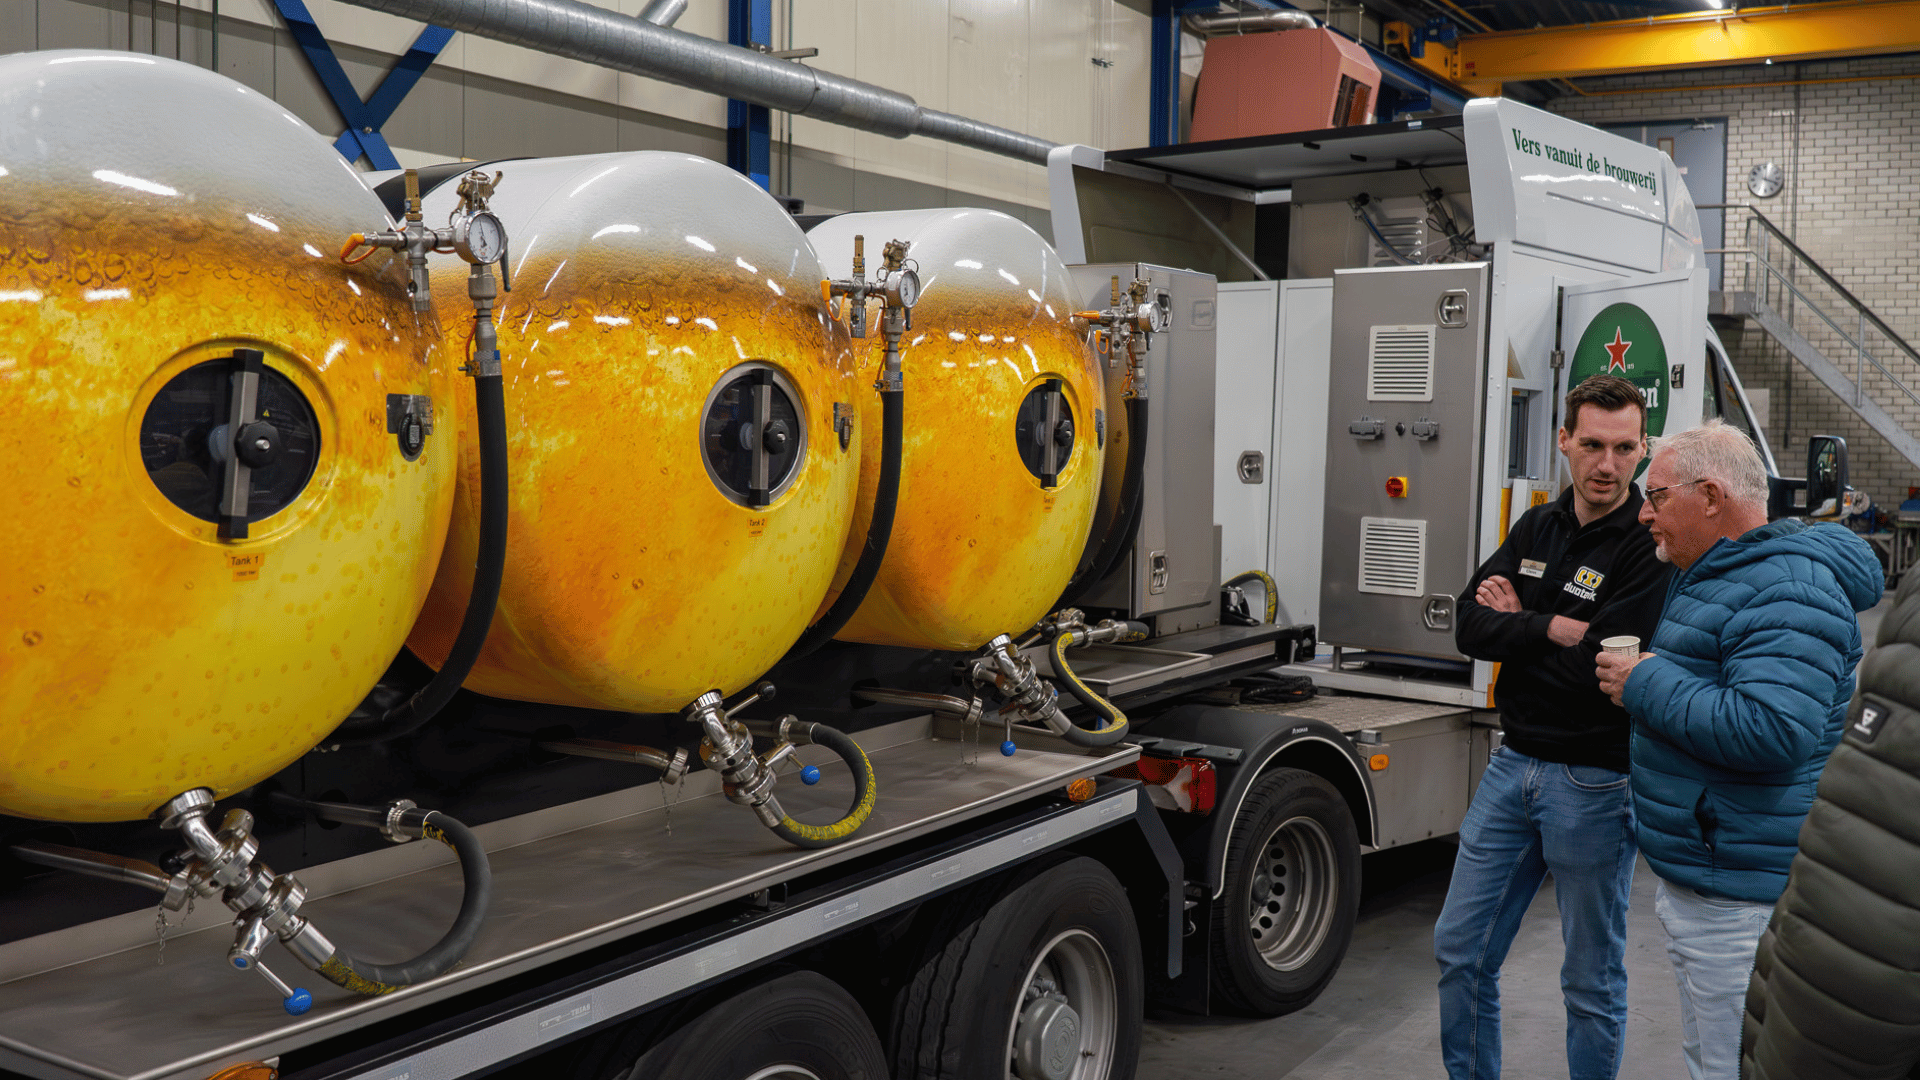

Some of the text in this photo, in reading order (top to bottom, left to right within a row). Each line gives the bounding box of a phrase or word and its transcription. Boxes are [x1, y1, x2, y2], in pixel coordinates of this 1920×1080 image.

[1512, 128, 1657, 196] Vers vanuit de brouwerij
[231, 555, 259, 566] Tank 1
